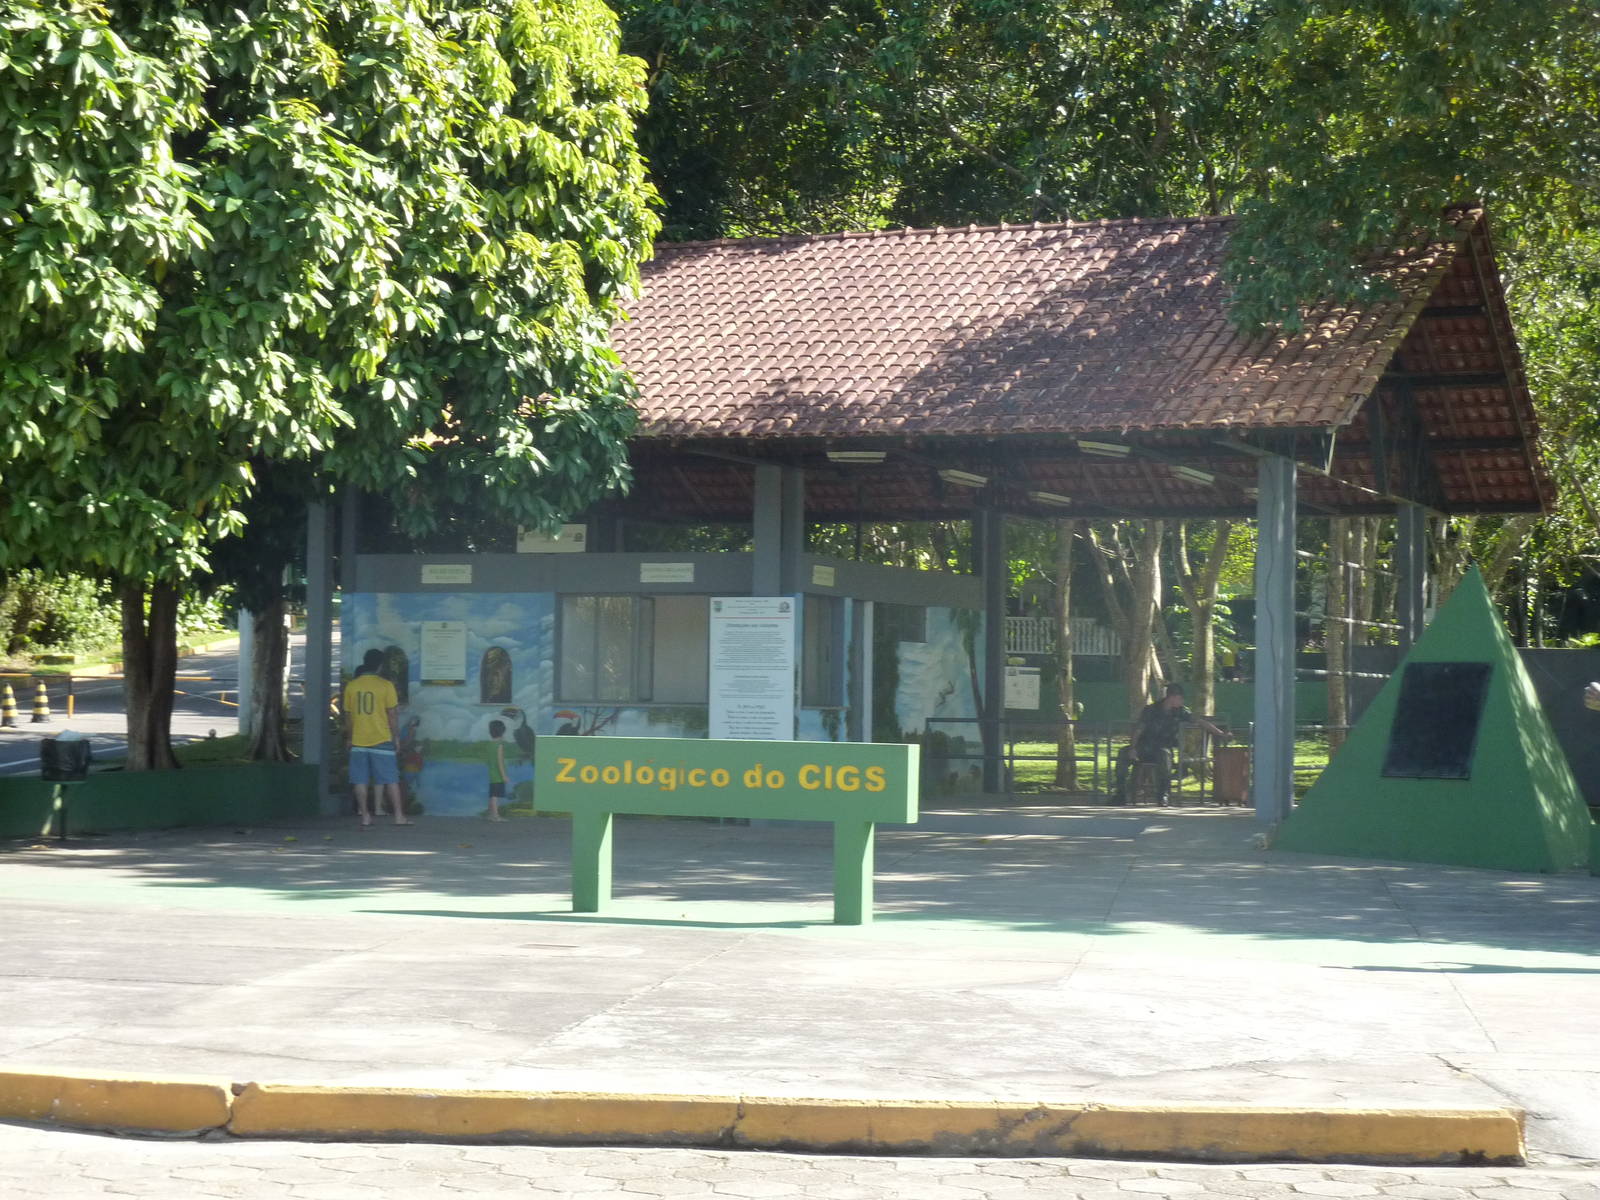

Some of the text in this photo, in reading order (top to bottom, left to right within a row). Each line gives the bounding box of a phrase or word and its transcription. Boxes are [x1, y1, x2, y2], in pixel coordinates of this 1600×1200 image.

[356, 690, 375, 715] 10
[743, 763, 786, 789] do
[798, 763, 887, 793] CIGS
